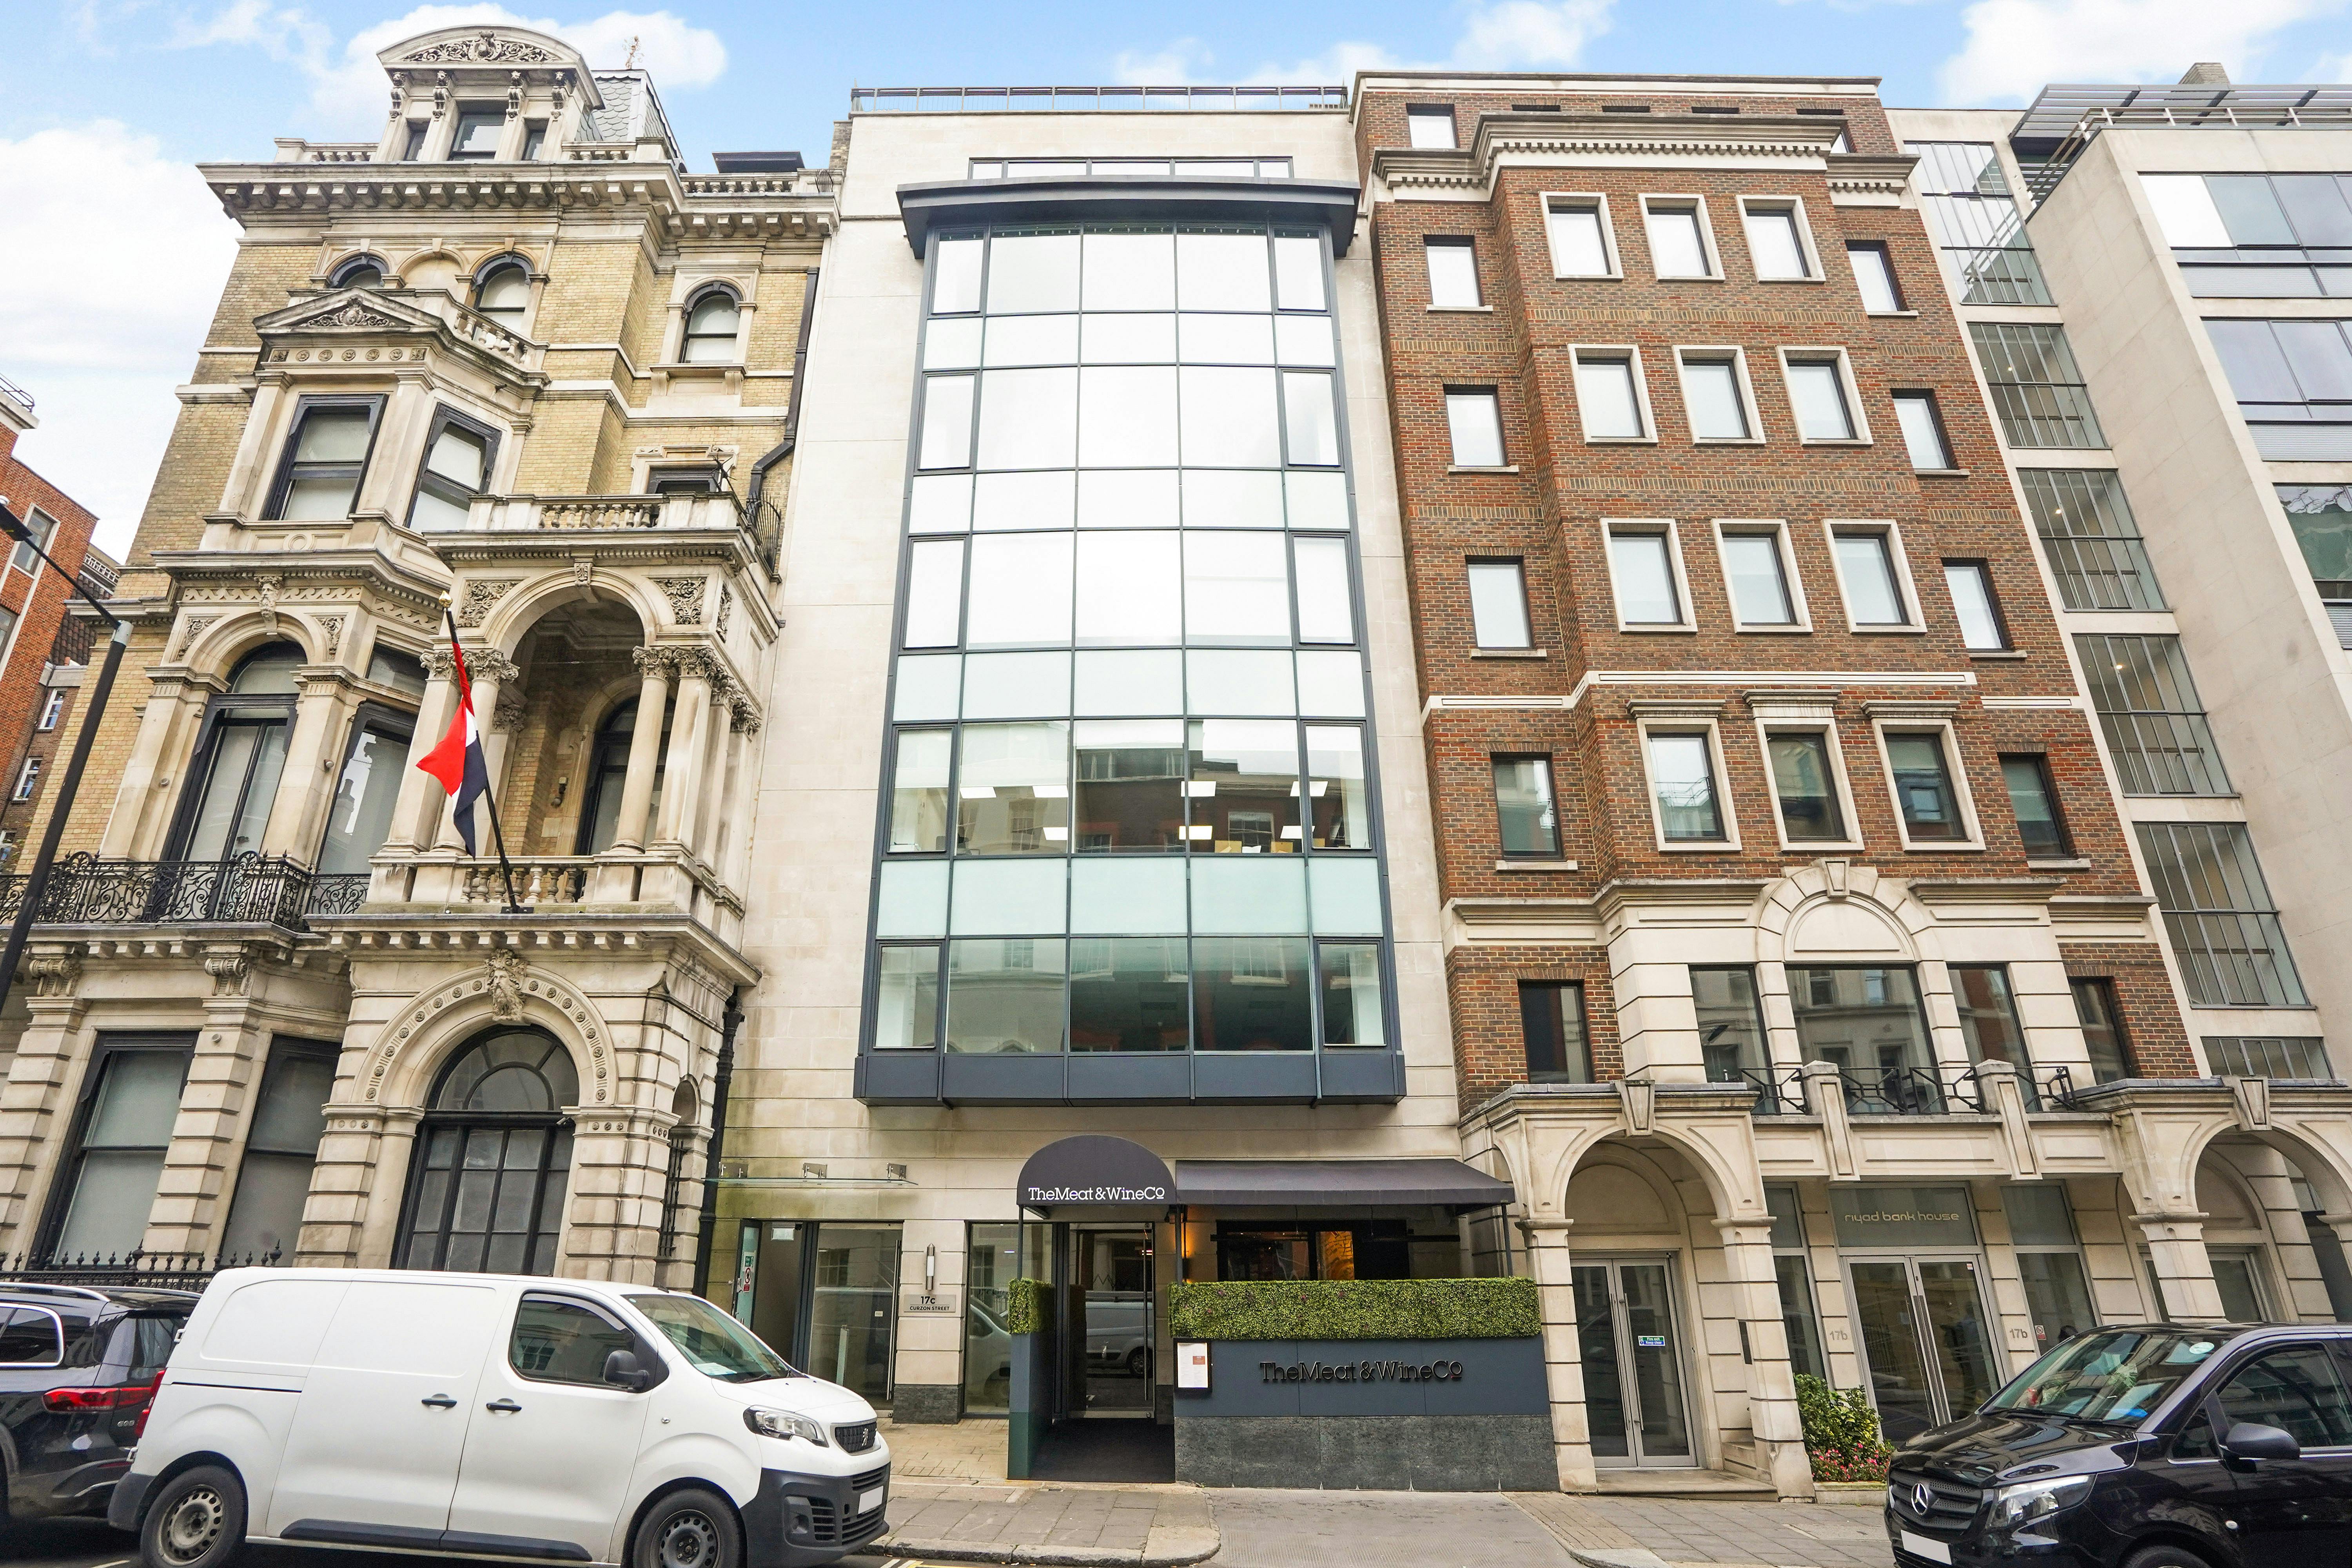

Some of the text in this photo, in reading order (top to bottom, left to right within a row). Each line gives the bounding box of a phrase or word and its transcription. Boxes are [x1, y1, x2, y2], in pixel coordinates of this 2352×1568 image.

[1845, 1210, 1959, 1224] riyad bank house
[921, 1296, 936, 1304] 17c
[1829, 1330, 1848, 1340] 17b
[2009, 1328, 2028, 1339] 17b
